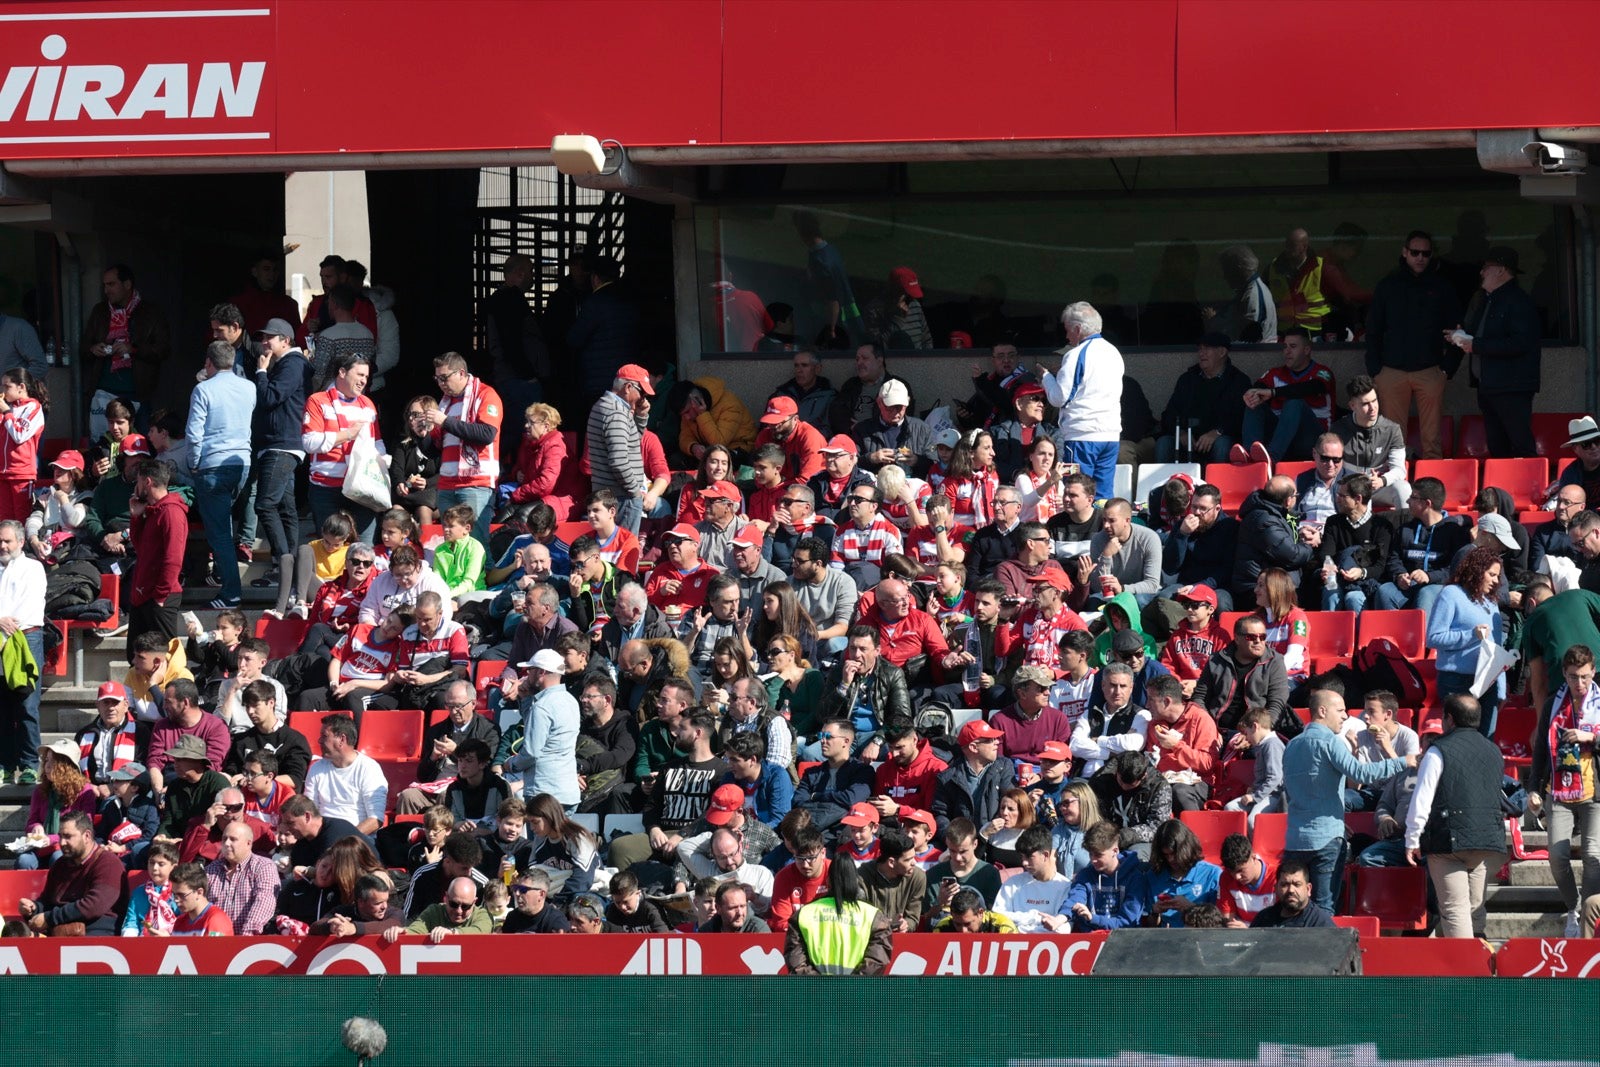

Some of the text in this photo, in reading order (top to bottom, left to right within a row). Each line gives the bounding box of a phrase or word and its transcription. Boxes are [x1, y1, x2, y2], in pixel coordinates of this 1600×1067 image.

[665, 768, 716, 793] NEVER
[661, 794, 709, 819] ENDIN
[936, 940, 1104, 976] AUTOC
